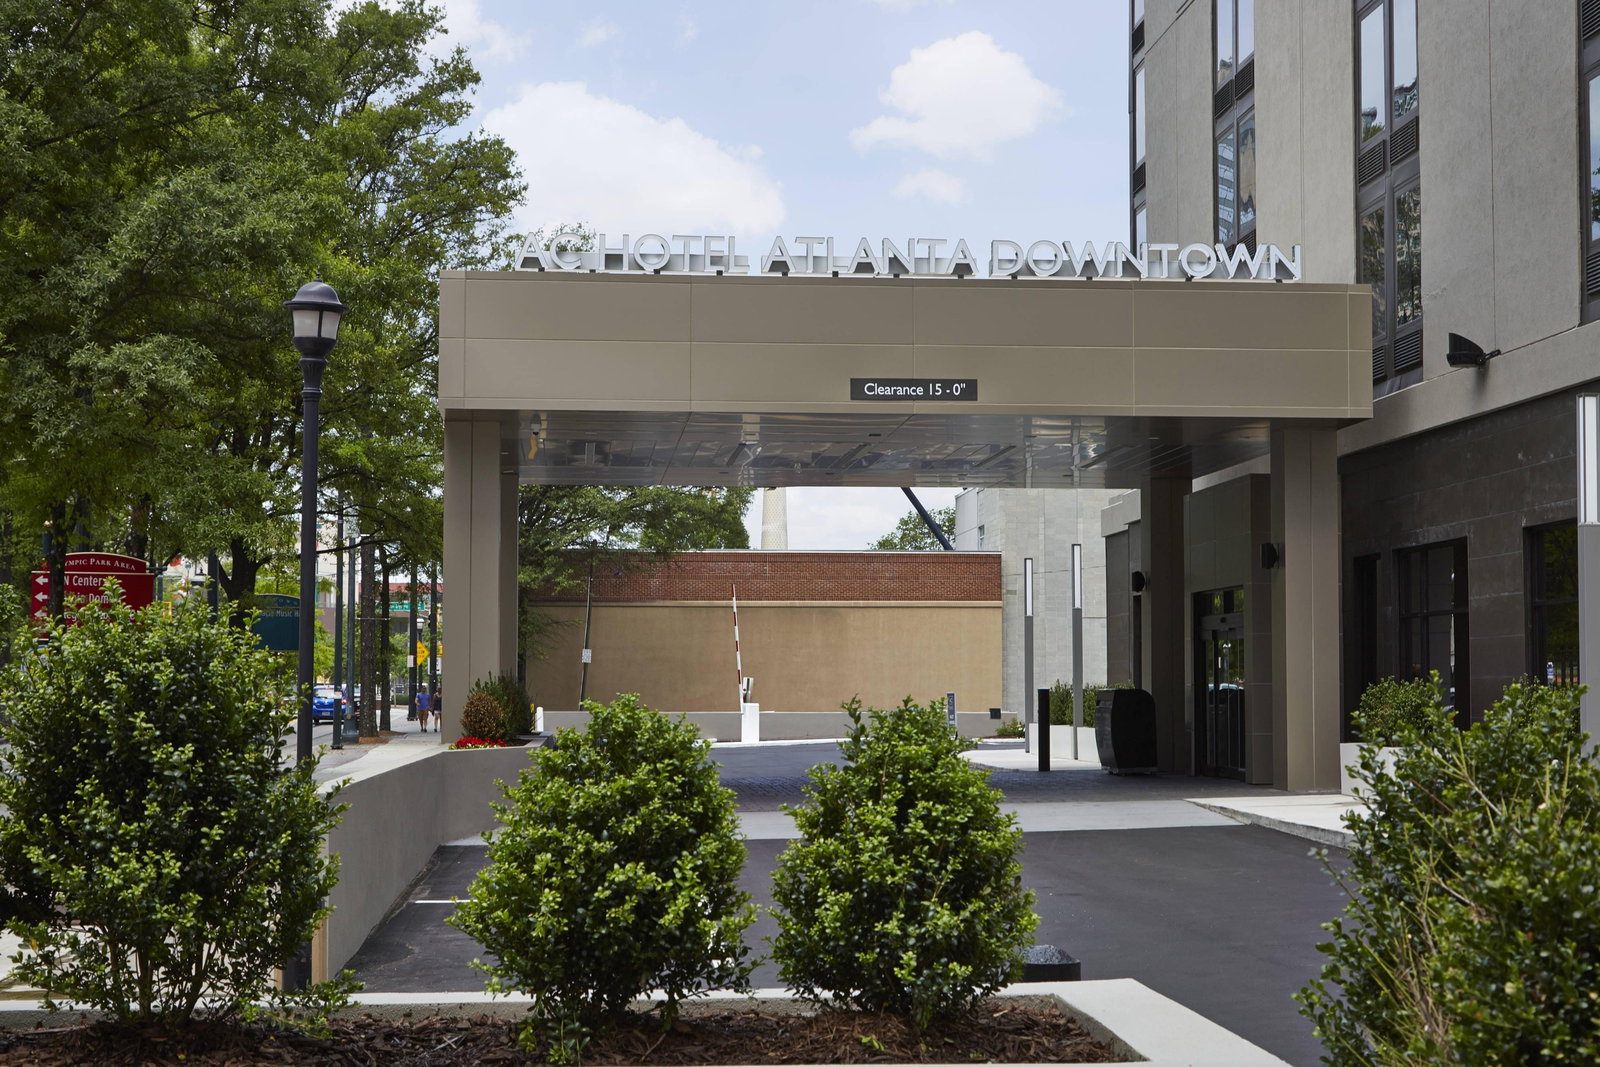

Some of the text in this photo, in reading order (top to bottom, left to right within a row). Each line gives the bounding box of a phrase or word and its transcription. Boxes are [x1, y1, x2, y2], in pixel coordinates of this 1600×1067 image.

[513, 231, 1302, 281] AC HOTEL ATLANTA DOWNTOWN
[864, 382, 924, 396] Clearance
[929, 383, 942, 395] 15
[65, 558, 136, 571] YMPIC PARK AREA
[72, 575, 103, 586] Center
